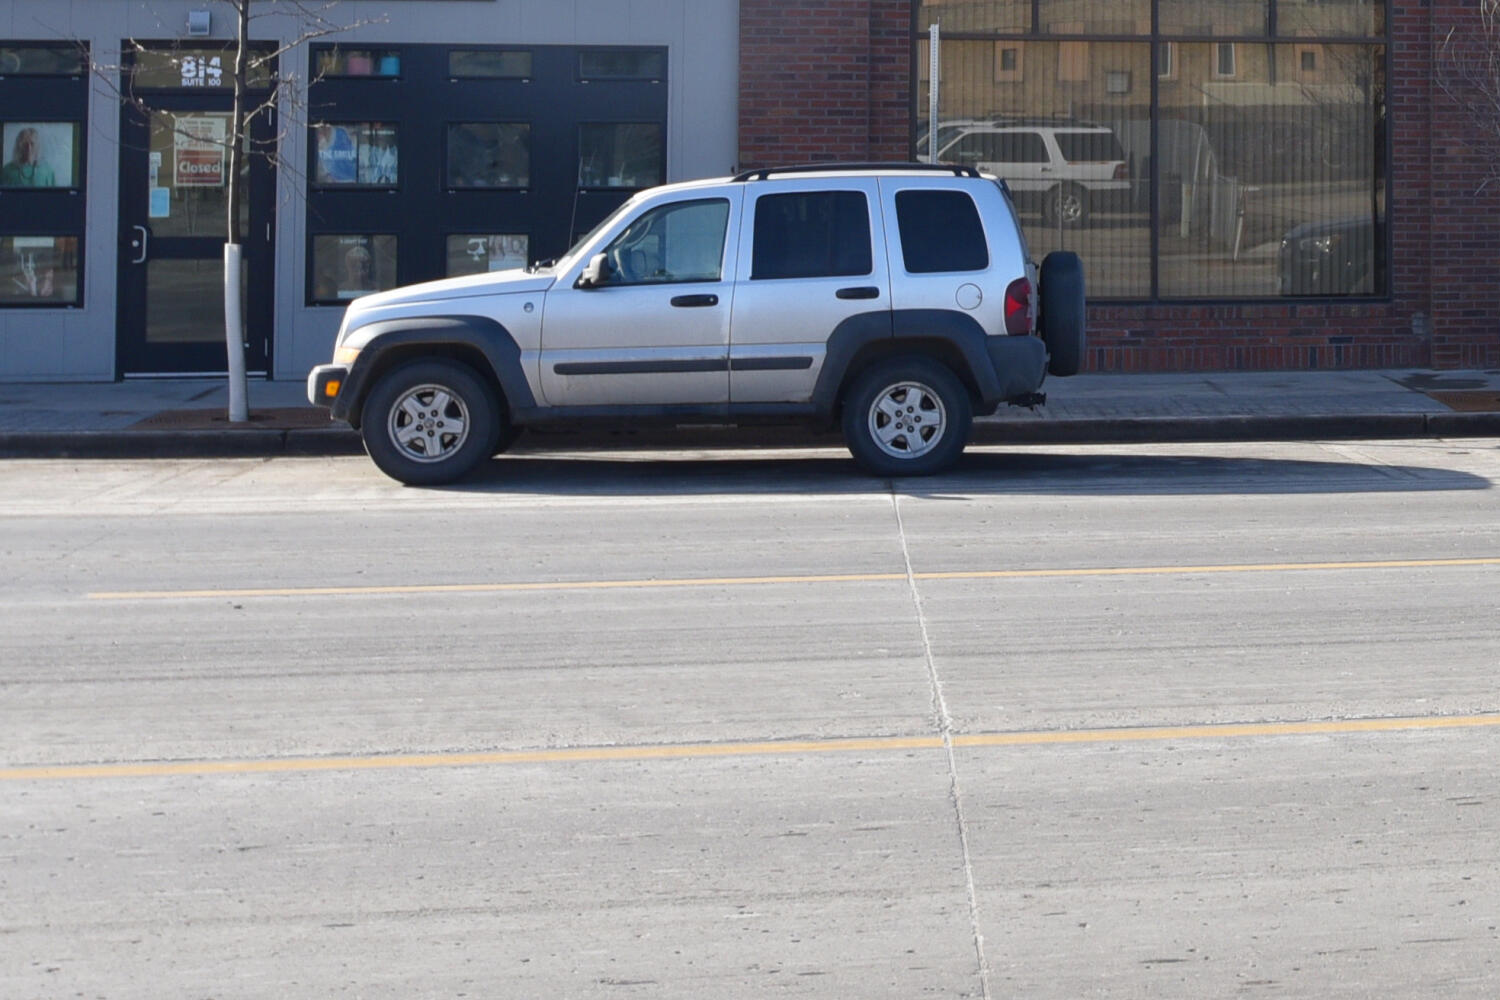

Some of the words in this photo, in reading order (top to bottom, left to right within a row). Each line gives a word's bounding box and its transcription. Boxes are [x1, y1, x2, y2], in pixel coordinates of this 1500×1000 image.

[181, 56, 222, 78] 814
[181, 79, 205, 87] SUITE
[208, 79, 222, 87] 100
[178, 161, 223, 174] Closed
